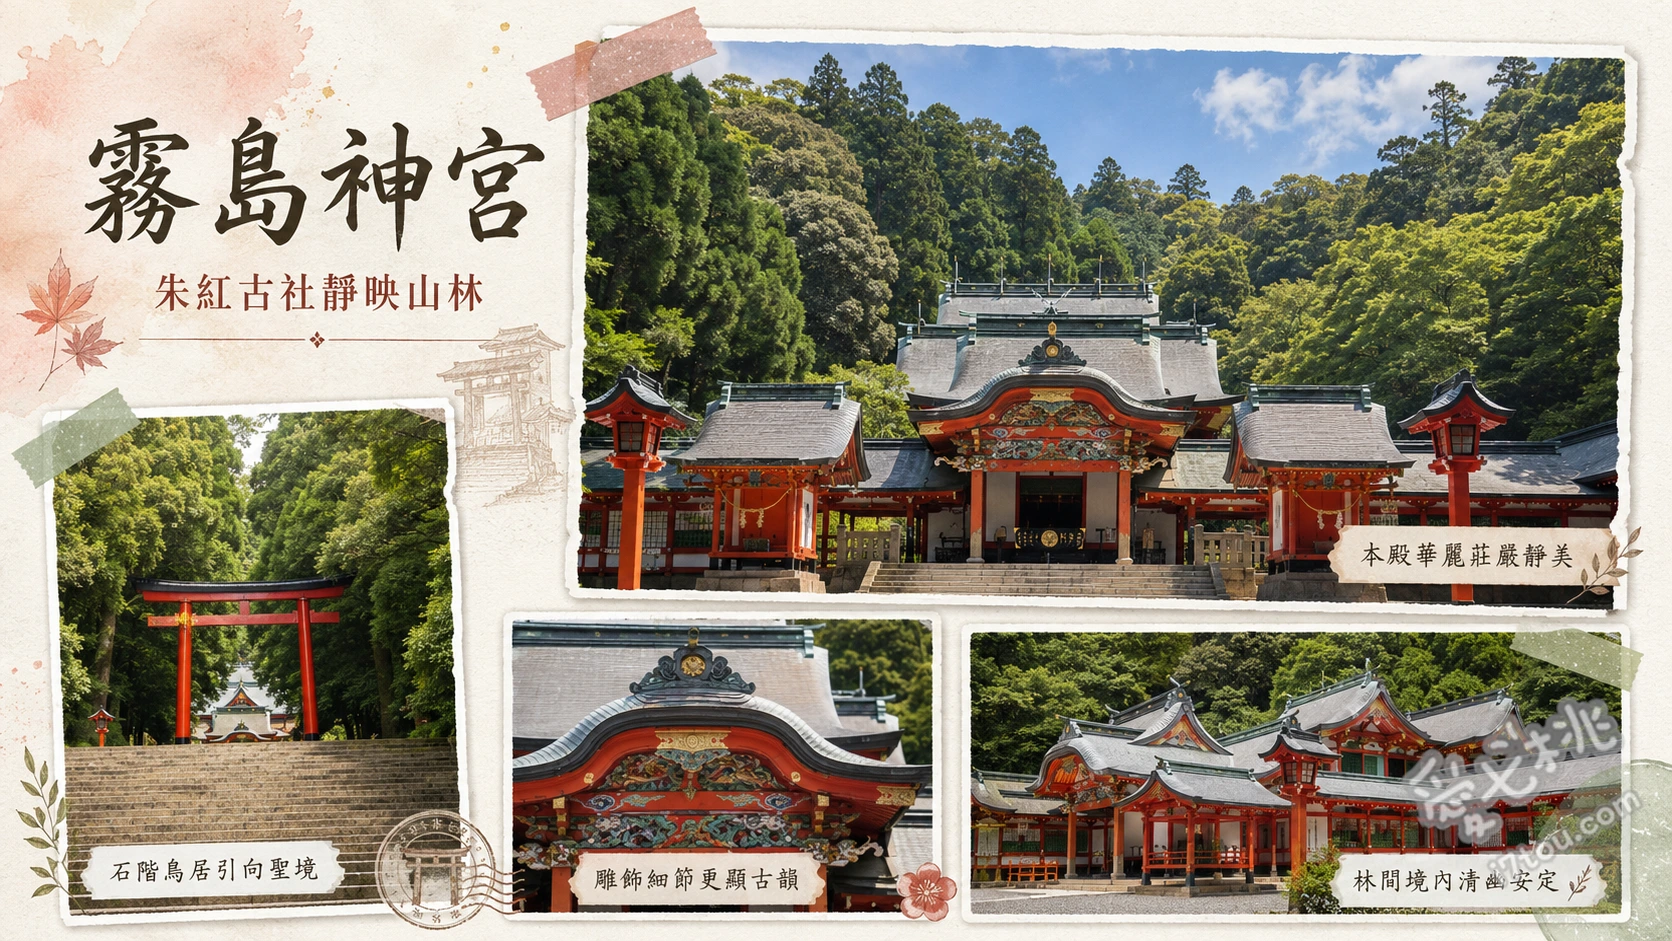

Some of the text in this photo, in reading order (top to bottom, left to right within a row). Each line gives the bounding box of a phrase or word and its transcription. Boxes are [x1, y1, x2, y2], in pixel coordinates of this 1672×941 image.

[85, 116, 545, 252] 霧島神宮
[155, 273, 484, 312] 朱紅古社靜映山林
[1360, 541, 1574, 569] 本殿華麗莊嚴靜美
[110, 856, 319, 883] 石階鳥居引向聖境
[593, 866, 800, 892] 雕飾細節更顯古韻
[1353, 867, 1560, 893] 林間境內清幽安定
